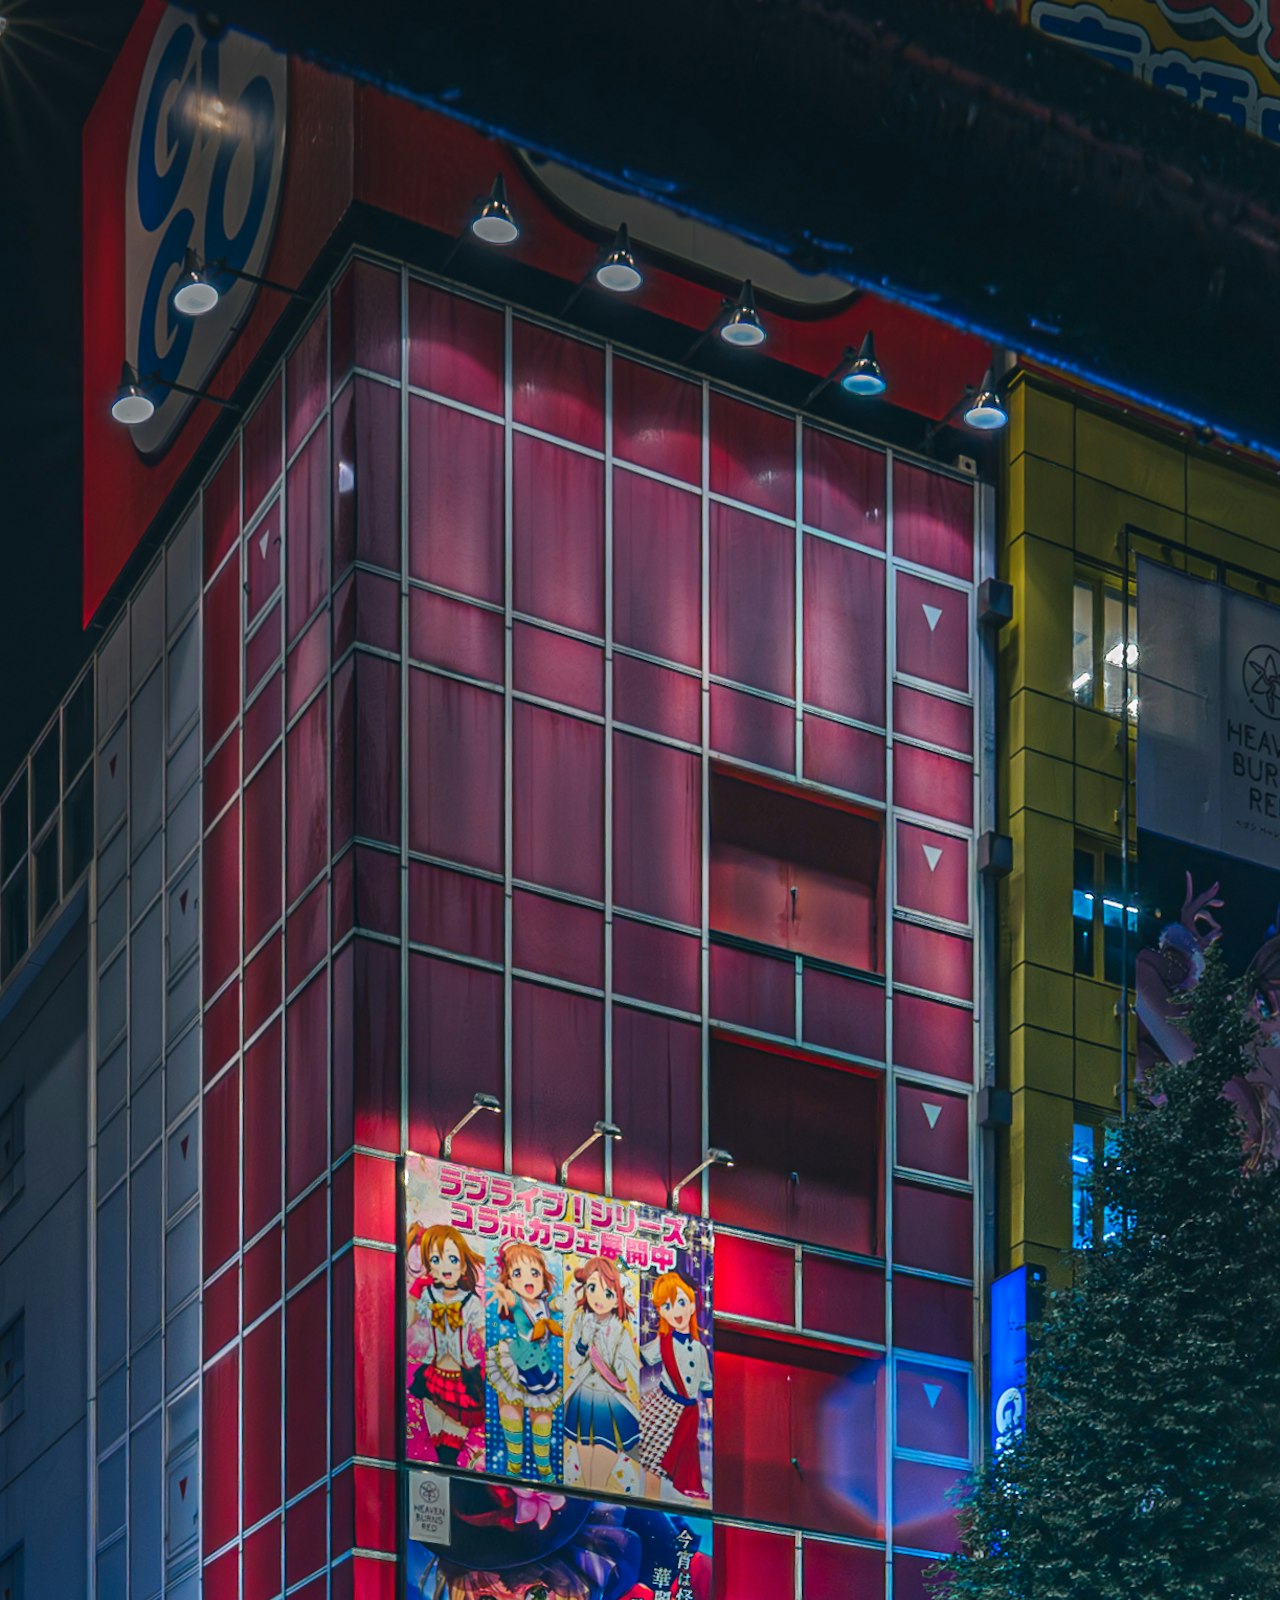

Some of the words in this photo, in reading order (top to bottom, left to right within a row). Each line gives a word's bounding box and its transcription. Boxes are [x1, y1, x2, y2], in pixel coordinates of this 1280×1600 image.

[450, 1202, 676, 1272] コラボカフェ展開中
[413, 1504, 446, 1518] HEAVEN
[413, 1512, 444, 1526] BURNS
[420, 1521, 438, 1533] RED
